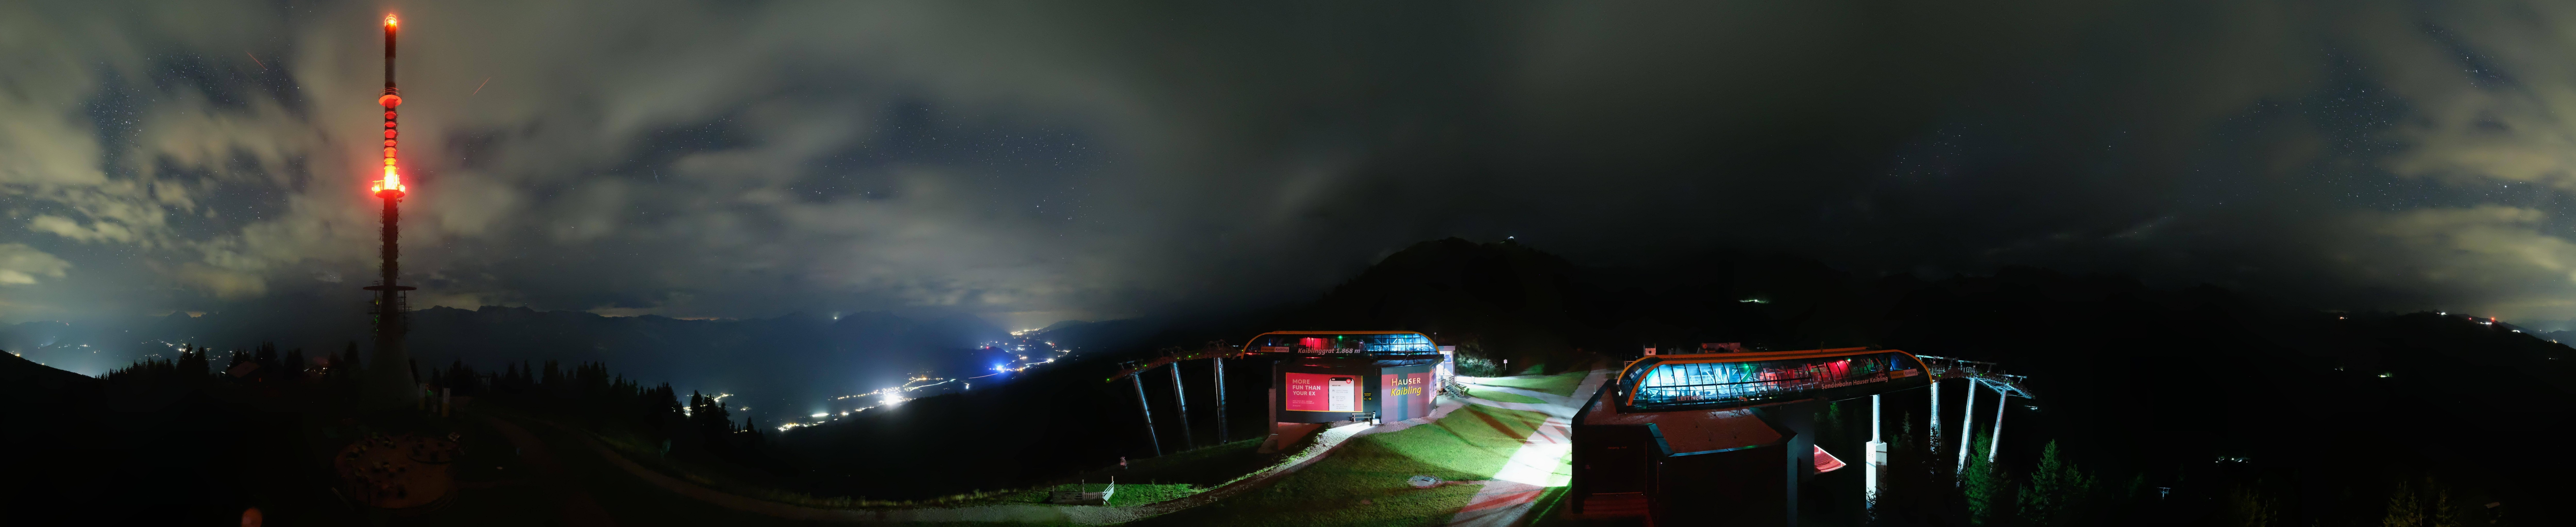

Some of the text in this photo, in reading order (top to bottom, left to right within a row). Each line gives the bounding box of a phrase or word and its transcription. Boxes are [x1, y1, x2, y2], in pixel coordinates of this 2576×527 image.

[1391, 378, 1421, 386] HAUSER
[1821, 380, 1852, 389] Senderbahn
[1391, 386, 1421, 396] Kaibling
